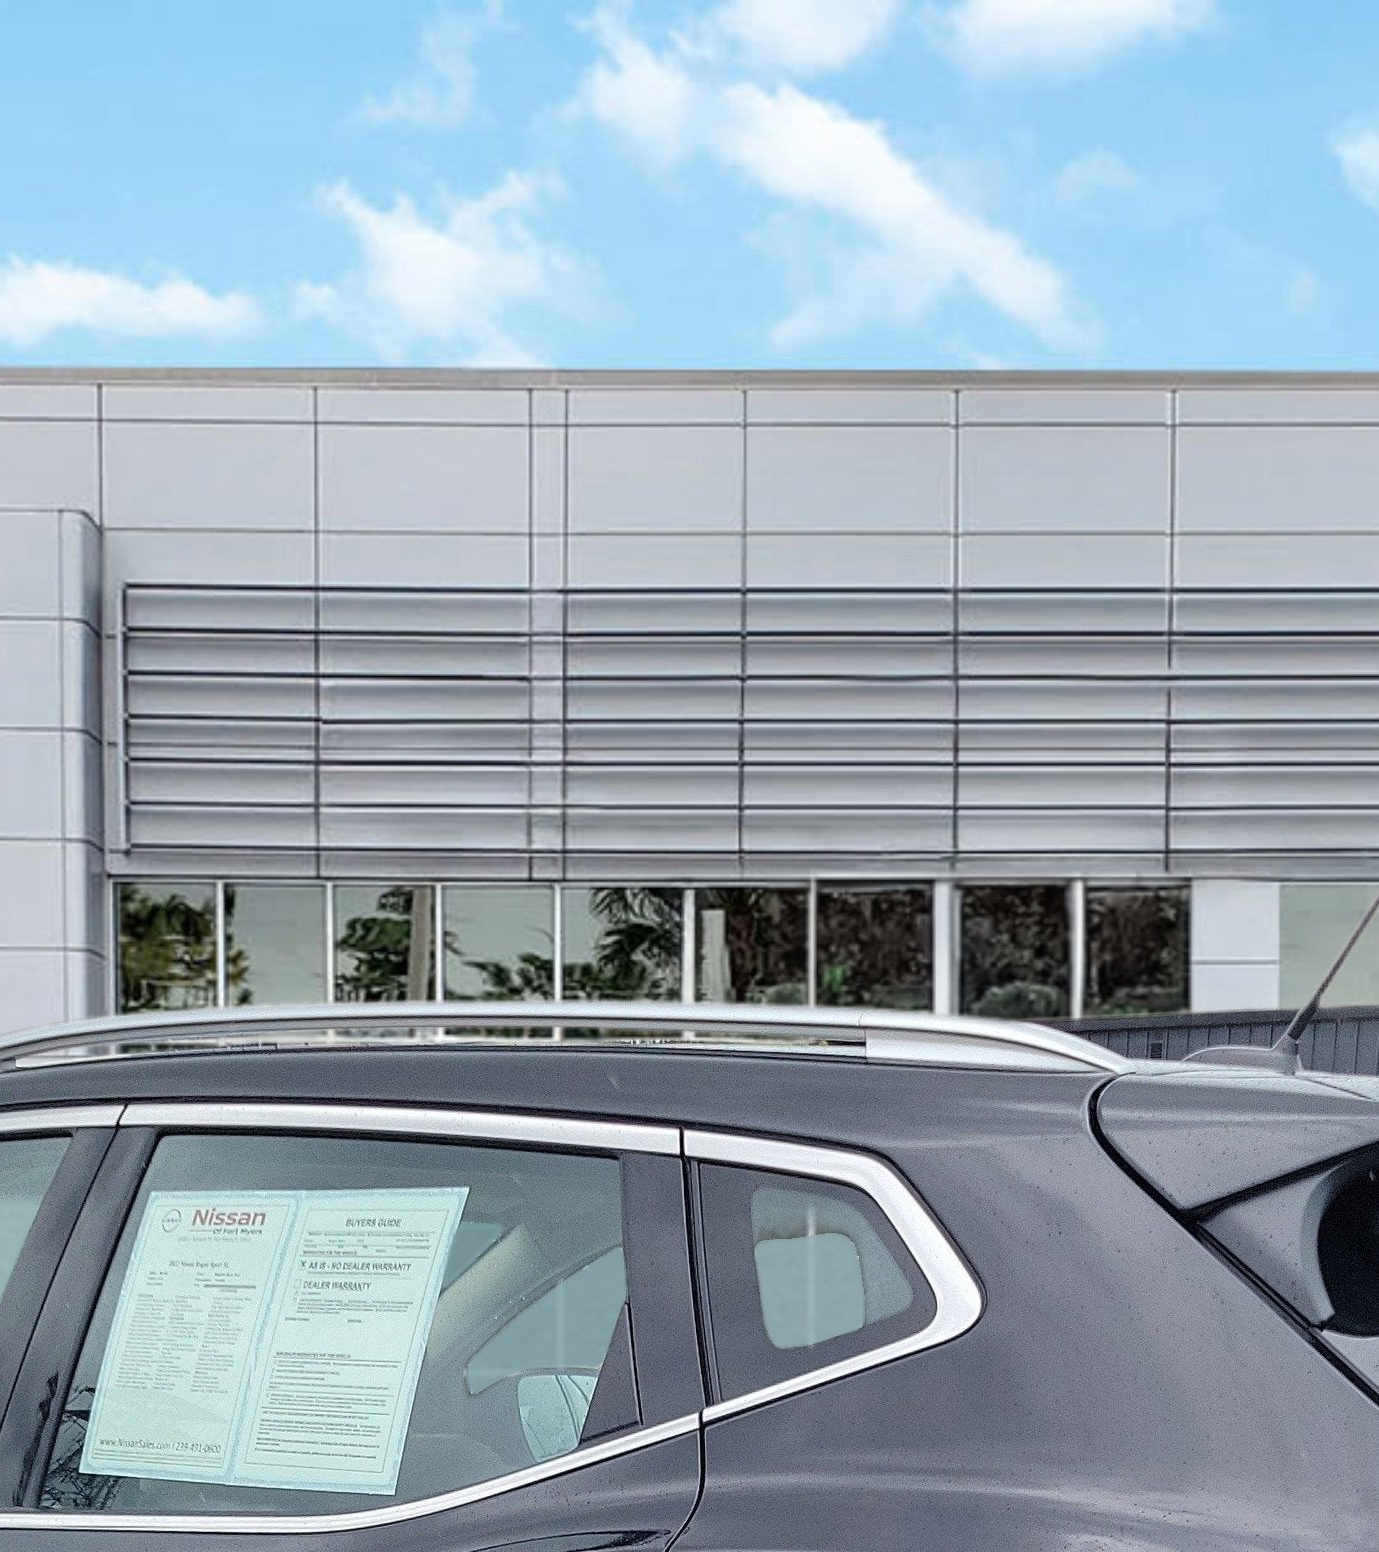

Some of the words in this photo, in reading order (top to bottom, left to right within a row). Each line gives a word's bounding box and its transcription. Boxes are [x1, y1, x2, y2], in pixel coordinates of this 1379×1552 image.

[191, 1207, 266, 1226] Nissan
[342, 1261, 371, 1272] DEALER
[303, 1280, 331, 1291] DEALER
